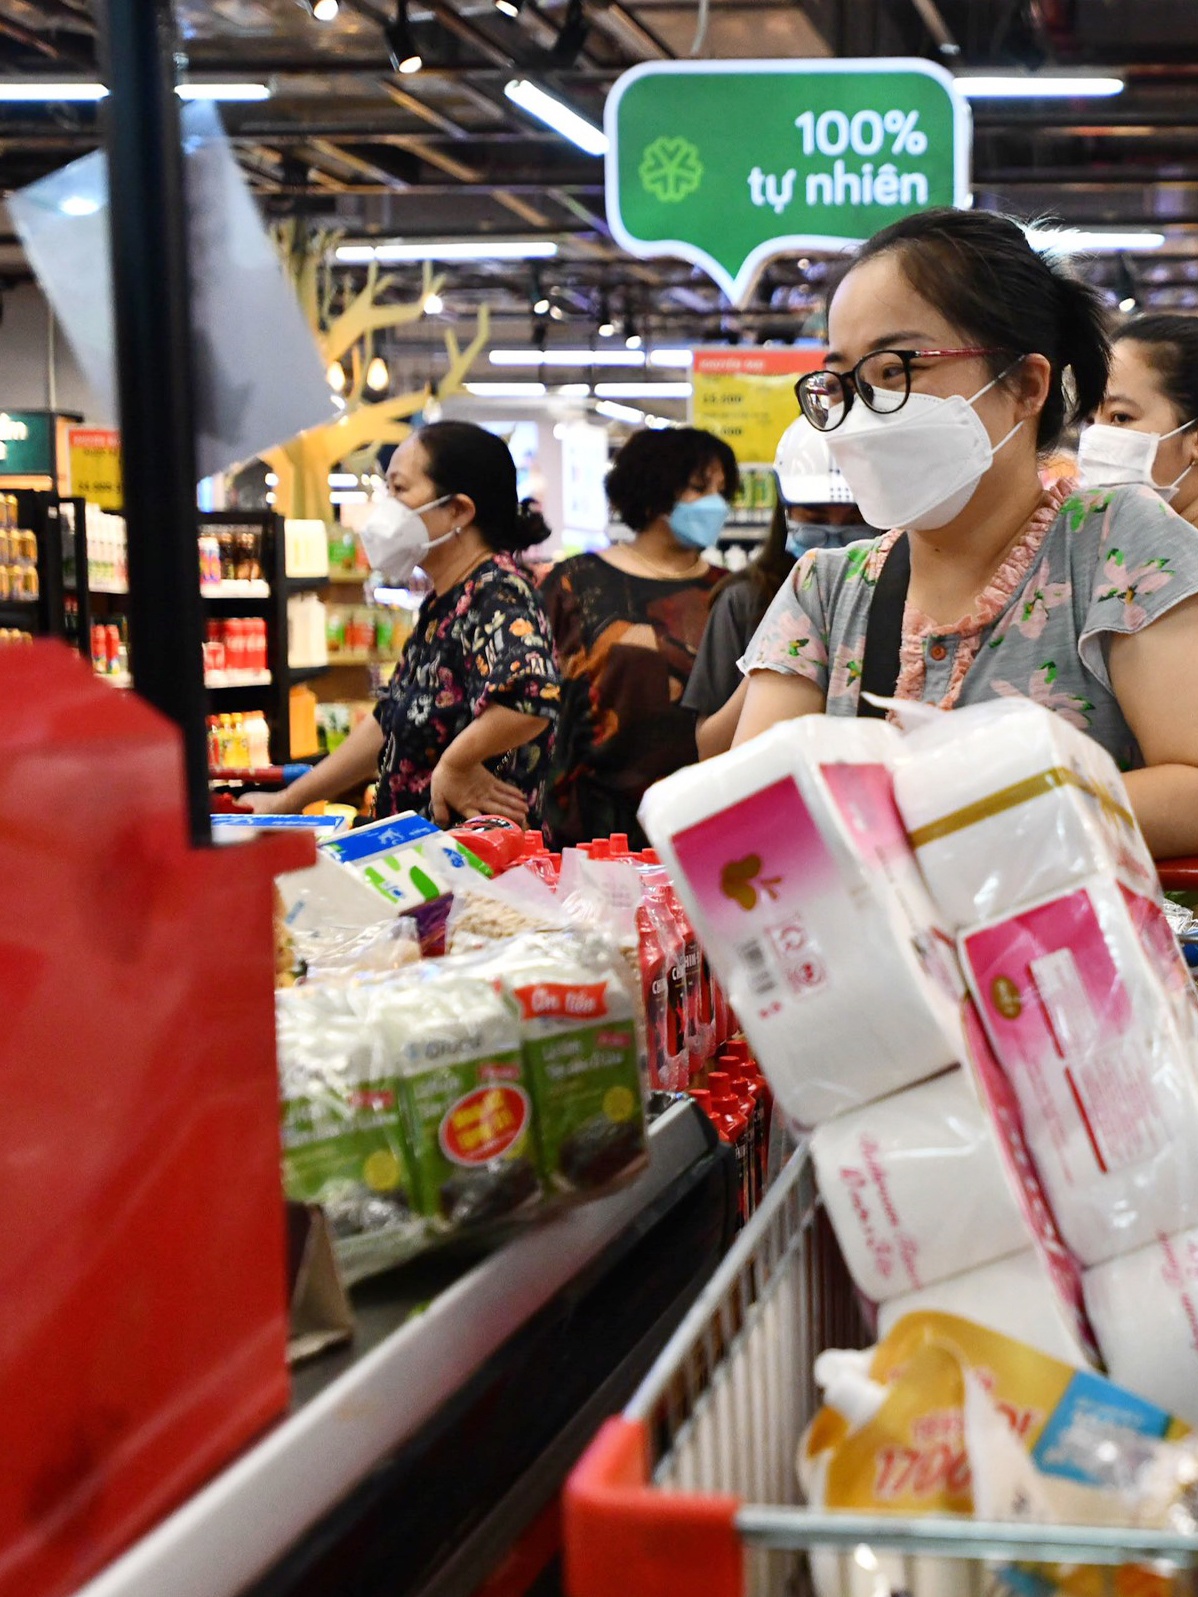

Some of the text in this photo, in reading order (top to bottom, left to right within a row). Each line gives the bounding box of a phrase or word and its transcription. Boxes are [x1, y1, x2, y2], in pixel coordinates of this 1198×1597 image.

[795, 109, 929, 157] 100%
[747, 158, 930, 215] tự nhiên
